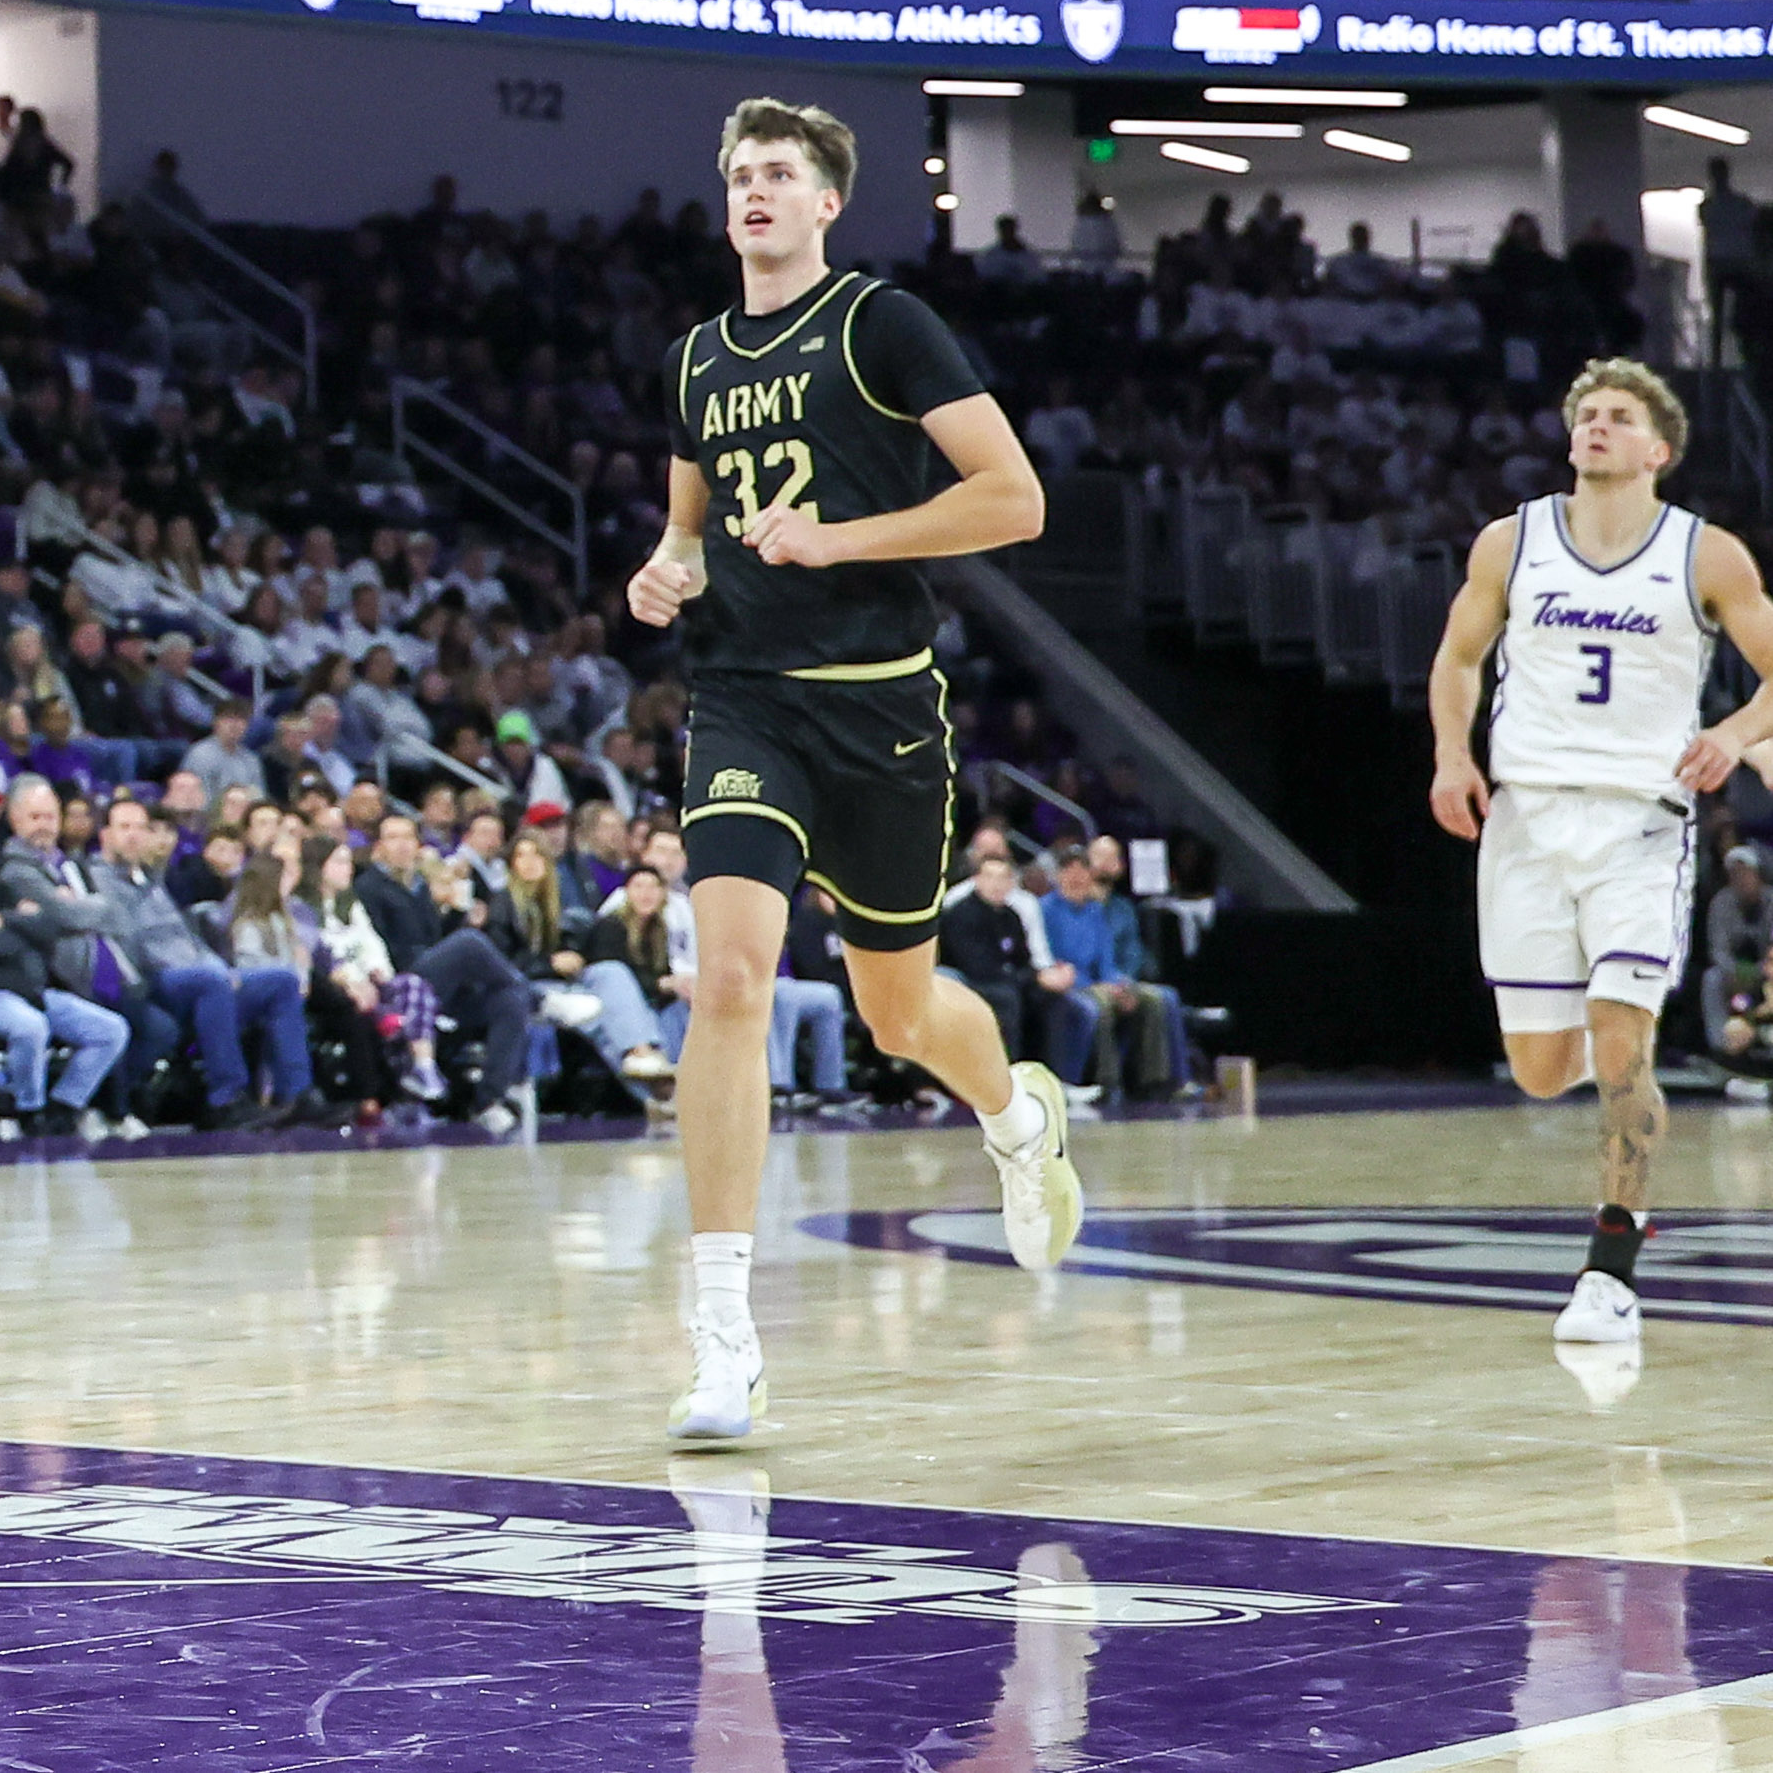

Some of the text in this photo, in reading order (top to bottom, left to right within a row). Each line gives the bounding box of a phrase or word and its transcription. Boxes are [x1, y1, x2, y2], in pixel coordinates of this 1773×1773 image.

[895, 4, 1043, 45] Athletics
[1336, 13, 1435, 55] Radio
[1435, 17, 1536, 56] Home
[1537, 17, 1579, 57] of
[1577, 20, 1625, 58] St.
[1625, 19, 1766, 59] Thomas
[497, 78, 564, 121] 122
[701, 371, 812, 441] ARMY
[715, 438, 820, 538] 32
[1533, 591, 1664, 635] Tommies
[1576, 642, 1612, 704] 3
[48, 1483, 974, 1561] LEAGUE
[422, 1579, 897, 1625] THE
